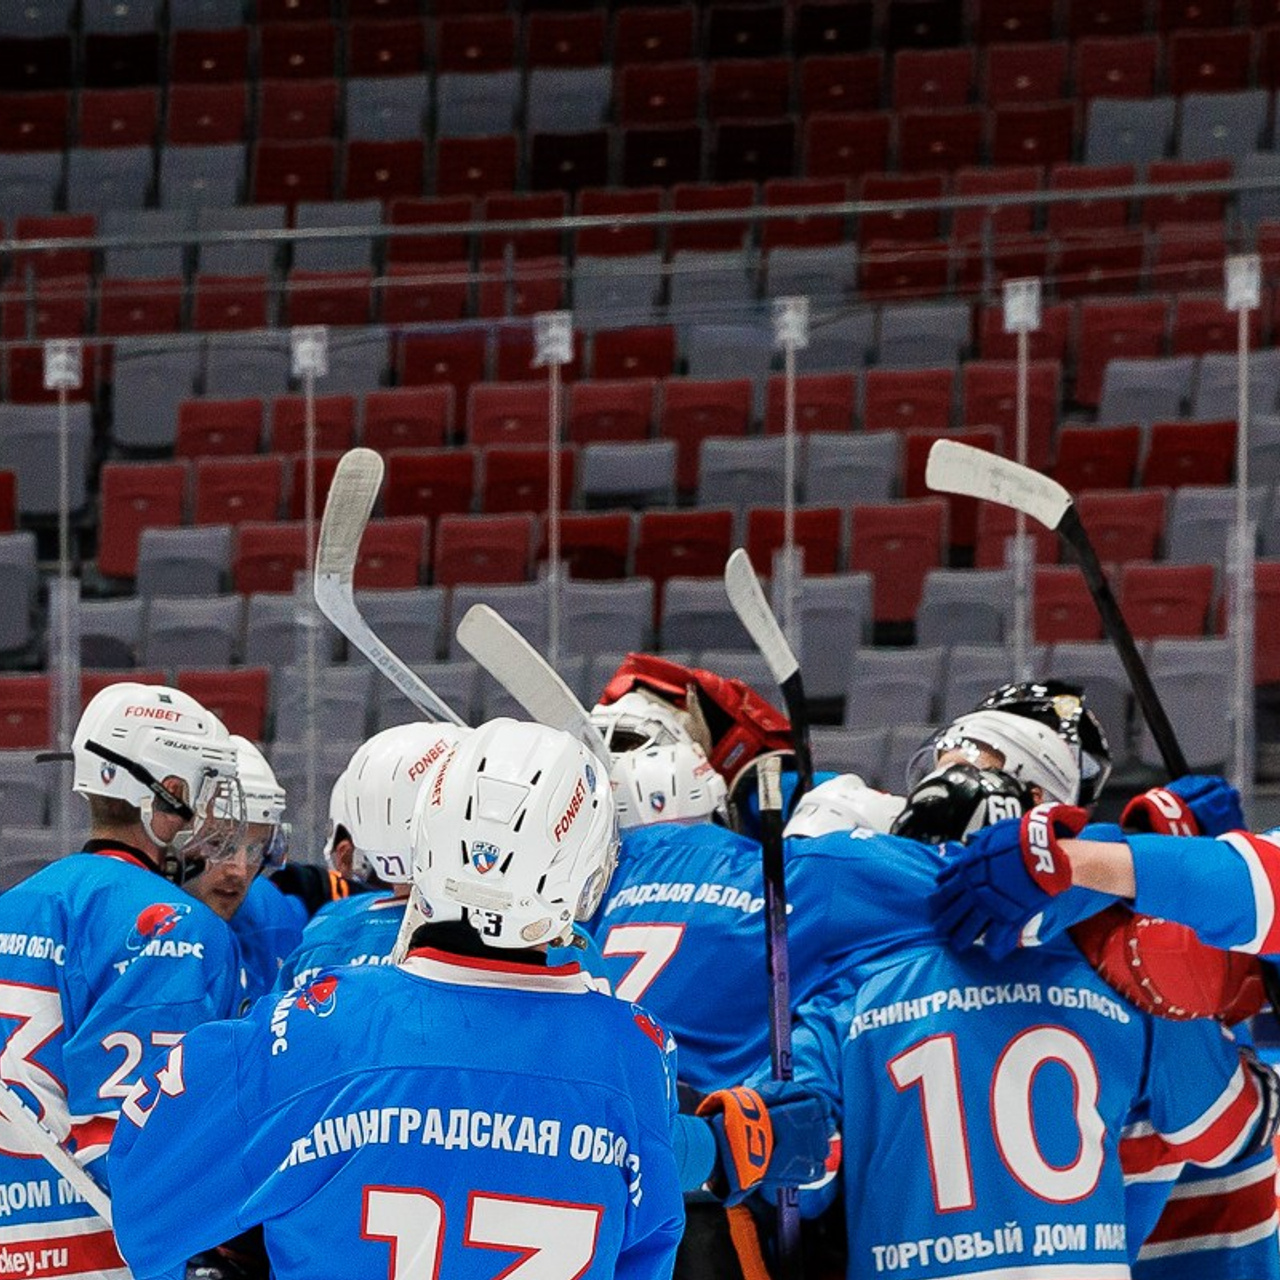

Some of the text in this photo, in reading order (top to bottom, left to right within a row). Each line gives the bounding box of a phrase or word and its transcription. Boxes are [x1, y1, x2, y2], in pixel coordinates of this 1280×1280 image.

[125, 705, 184, 722] FONBET
[408, 738, 450, 782] FONBET
[553, 777, 587, 843] FONBET
[376, 855, 406, 876] 27
[602, 922, 686, 1004] 7
[849, 983, 1042, 1040] ЛЕНИНГРАДСКАЯ
[886, 1023, 1107, 1215] 10
[872, 1221, 1024, 1272] ТОРГОВЫЙ
[1032, 1223, 1087, 1257] ДОМ
